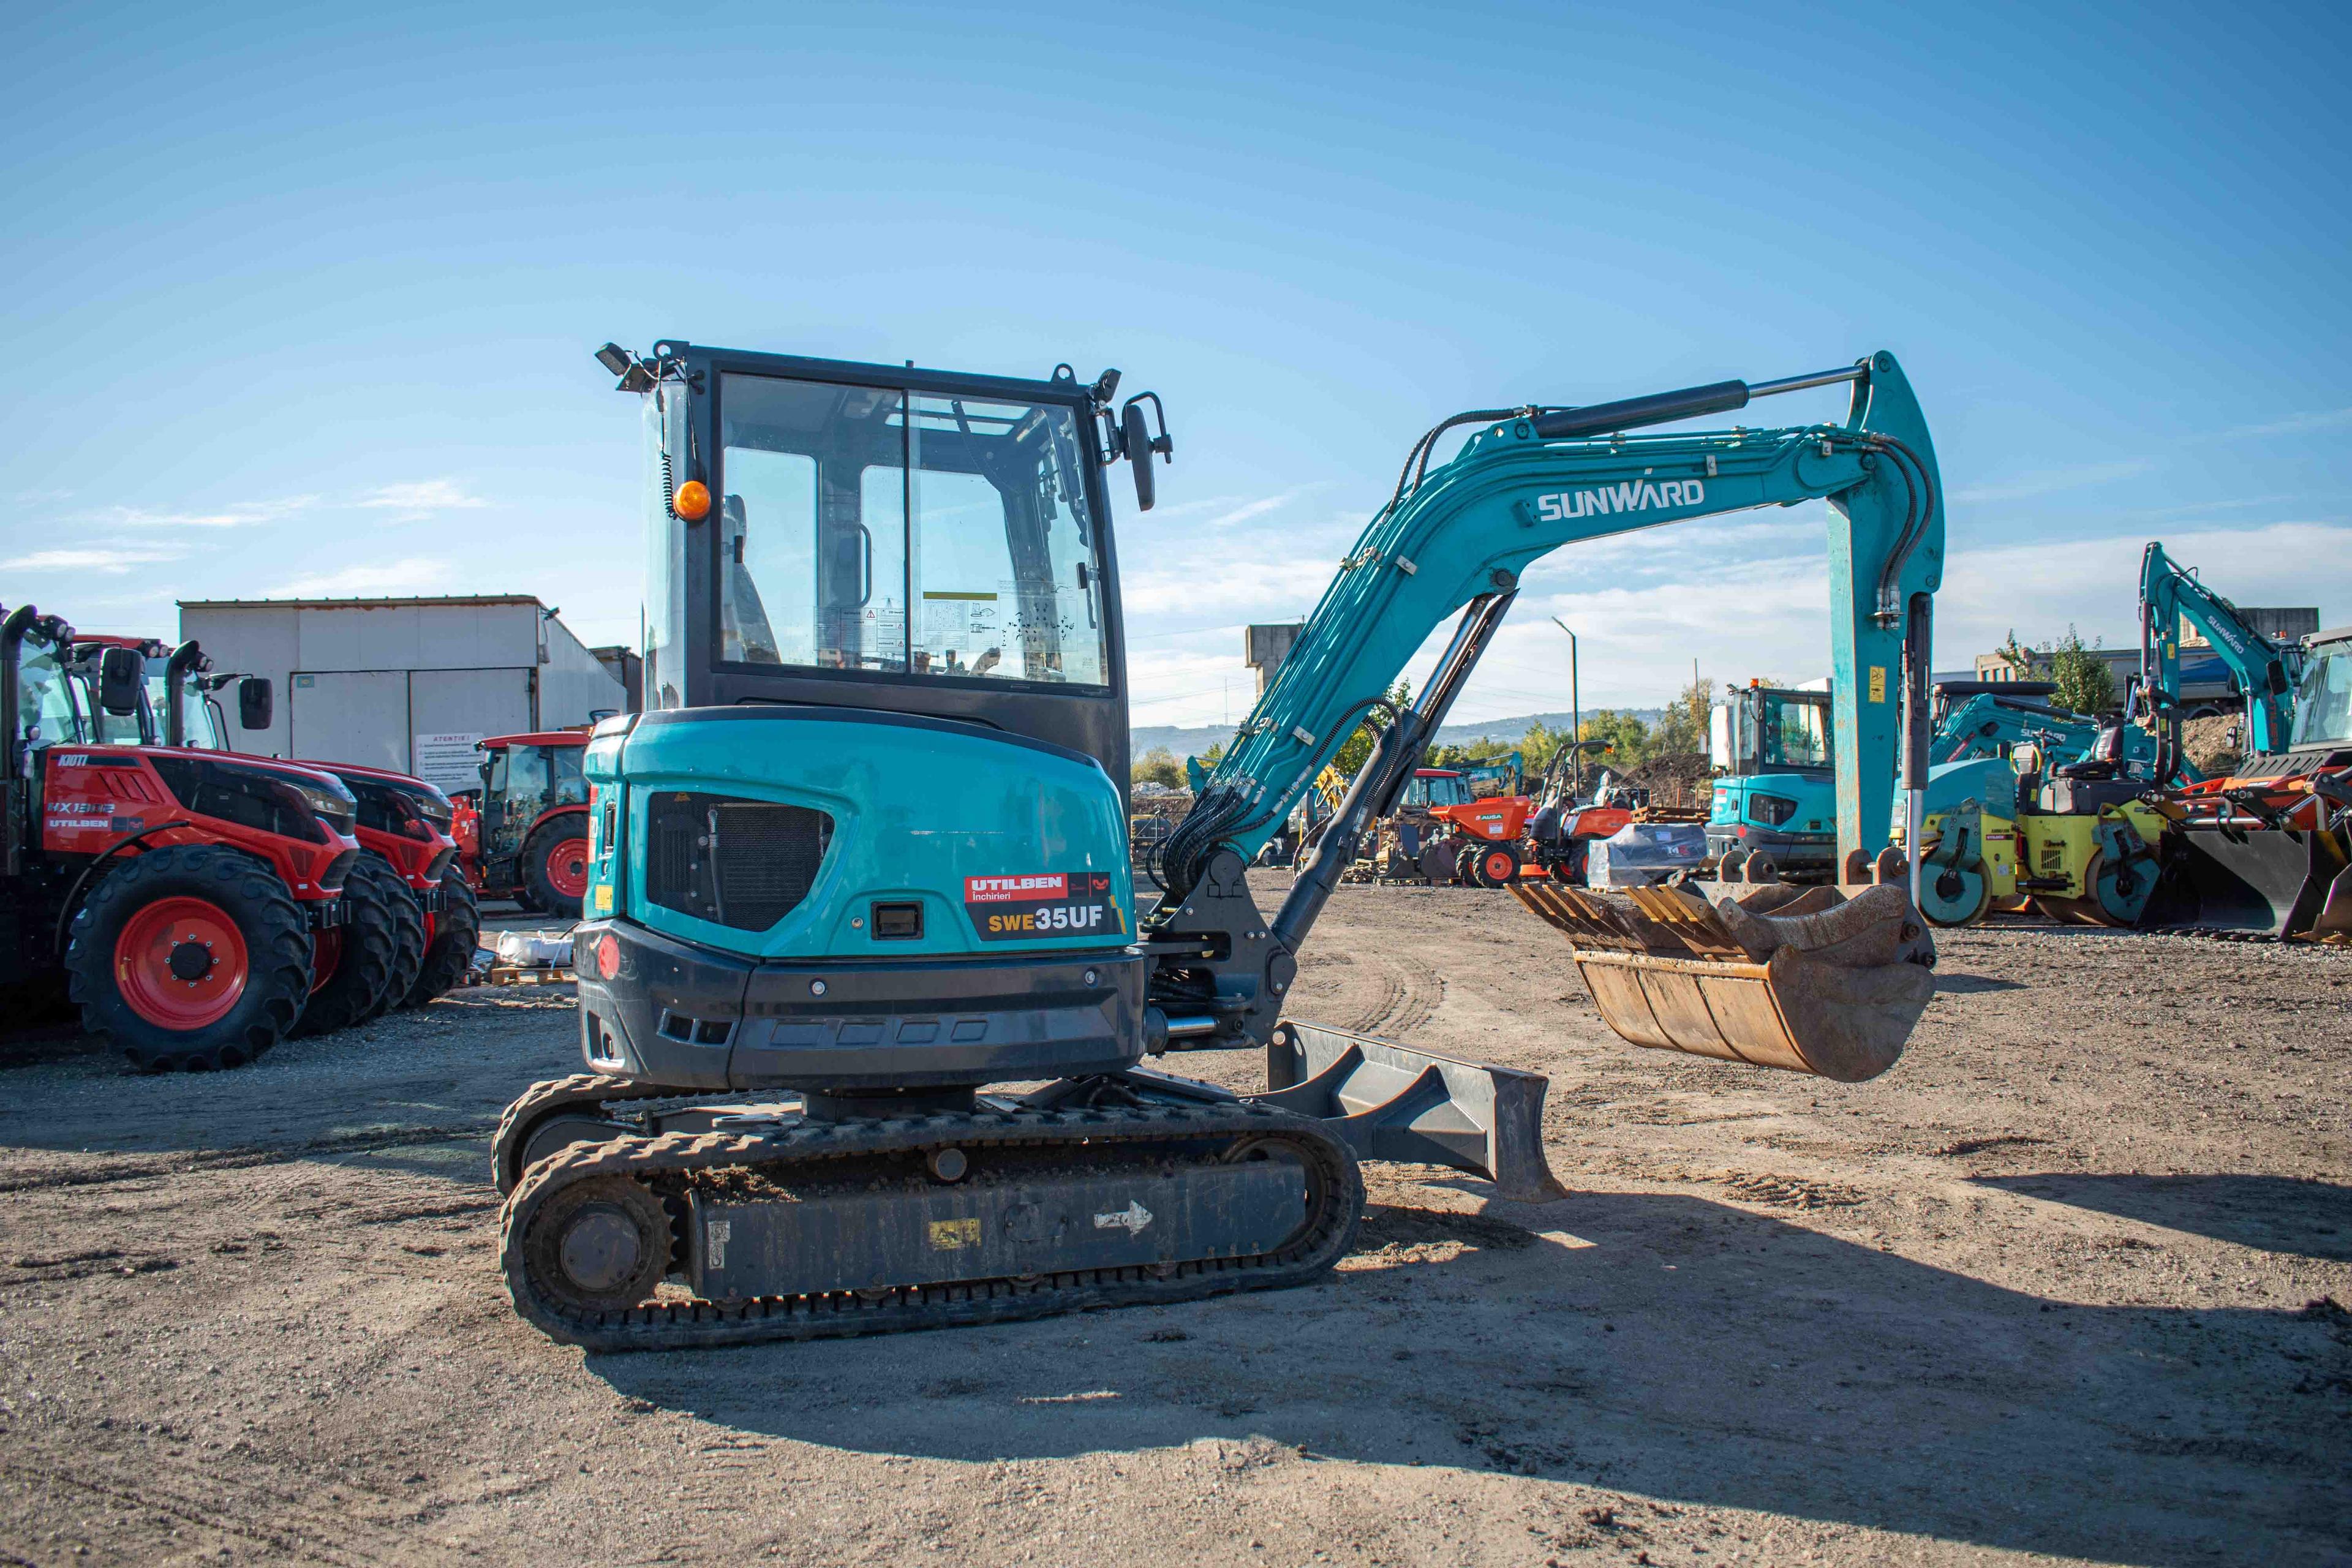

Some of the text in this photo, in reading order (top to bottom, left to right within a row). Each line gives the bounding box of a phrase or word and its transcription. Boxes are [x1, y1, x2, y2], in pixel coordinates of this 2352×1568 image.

[1537, 468, 1705, 521] SUNWARD
[2207, 615, 2244, 654] SUNWARD
[58, 754, 89, 766] KIOTI
[971, 876, 1062, 891] UTILBEN
[972, 891, 1011, 901] Închirieri
[989, 905, 1103, 932] SWE35UF
